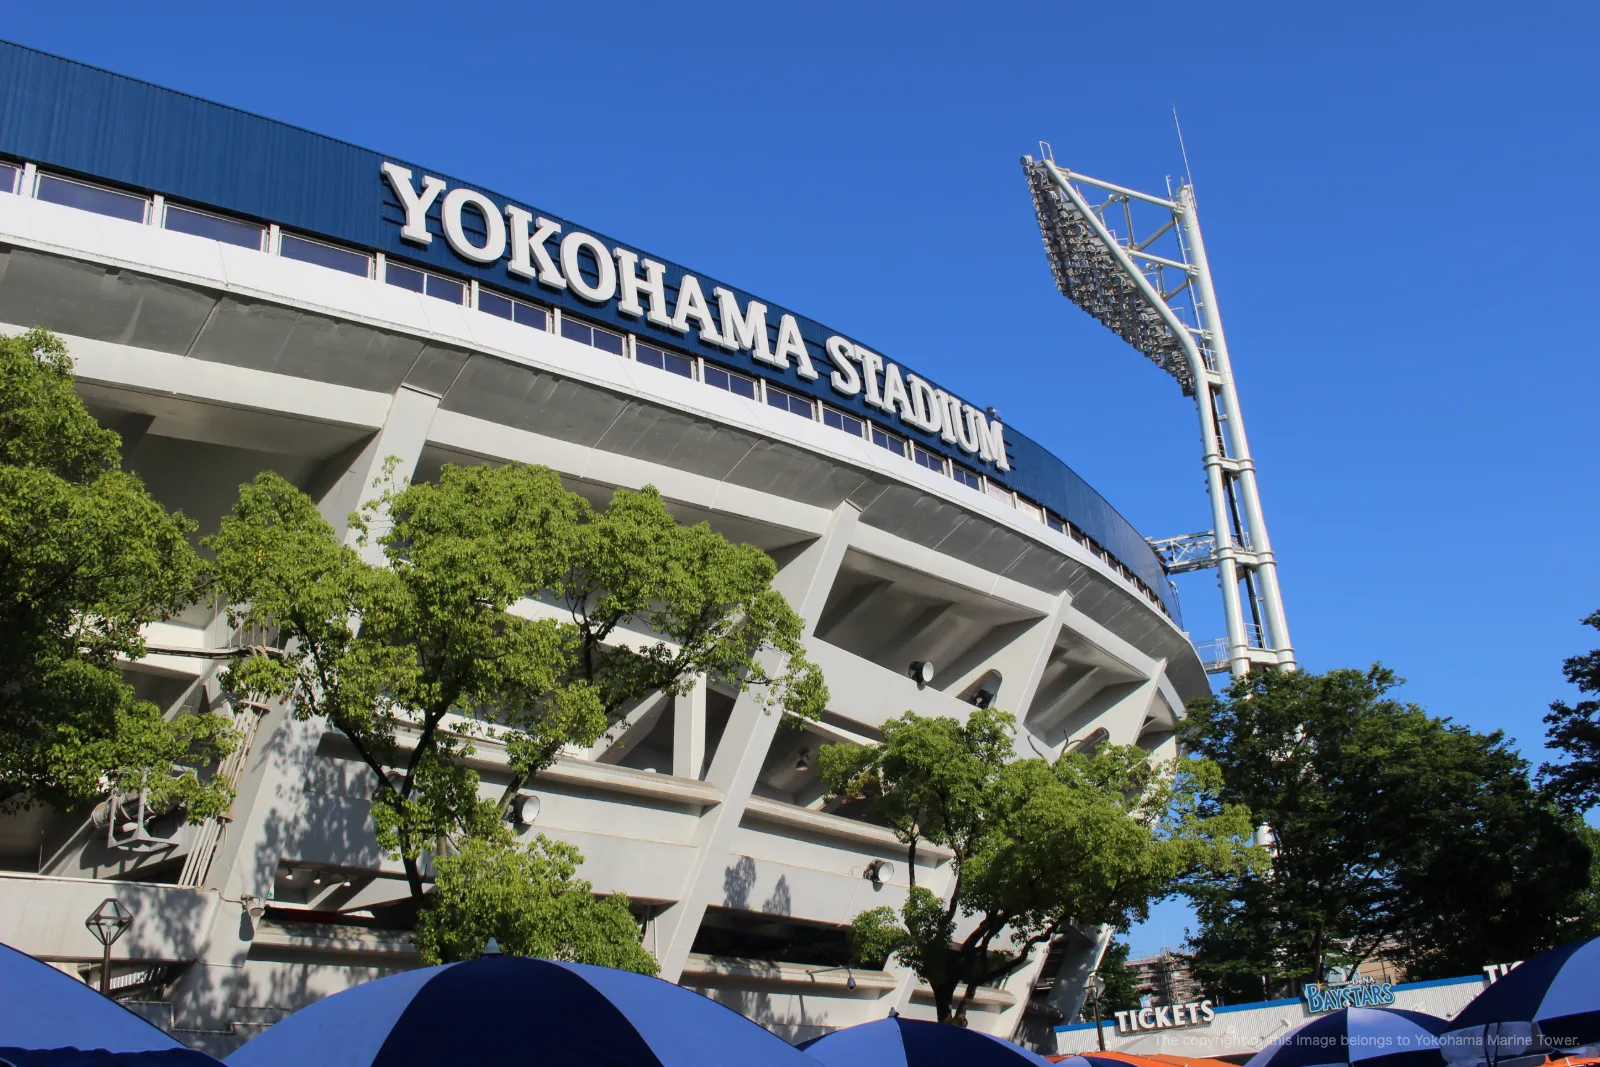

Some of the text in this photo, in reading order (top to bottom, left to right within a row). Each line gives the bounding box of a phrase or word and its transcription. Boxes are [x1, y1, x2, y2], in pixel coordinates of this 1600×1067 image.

[381, 161, 1010, 471] YOKOHAMA STADIUM
[1483, 960, 1524, 984] TI
[1305, 982, 1395, 1013] BAYSTARS
[1114, 1000, 1215, 1033] TICKETS
